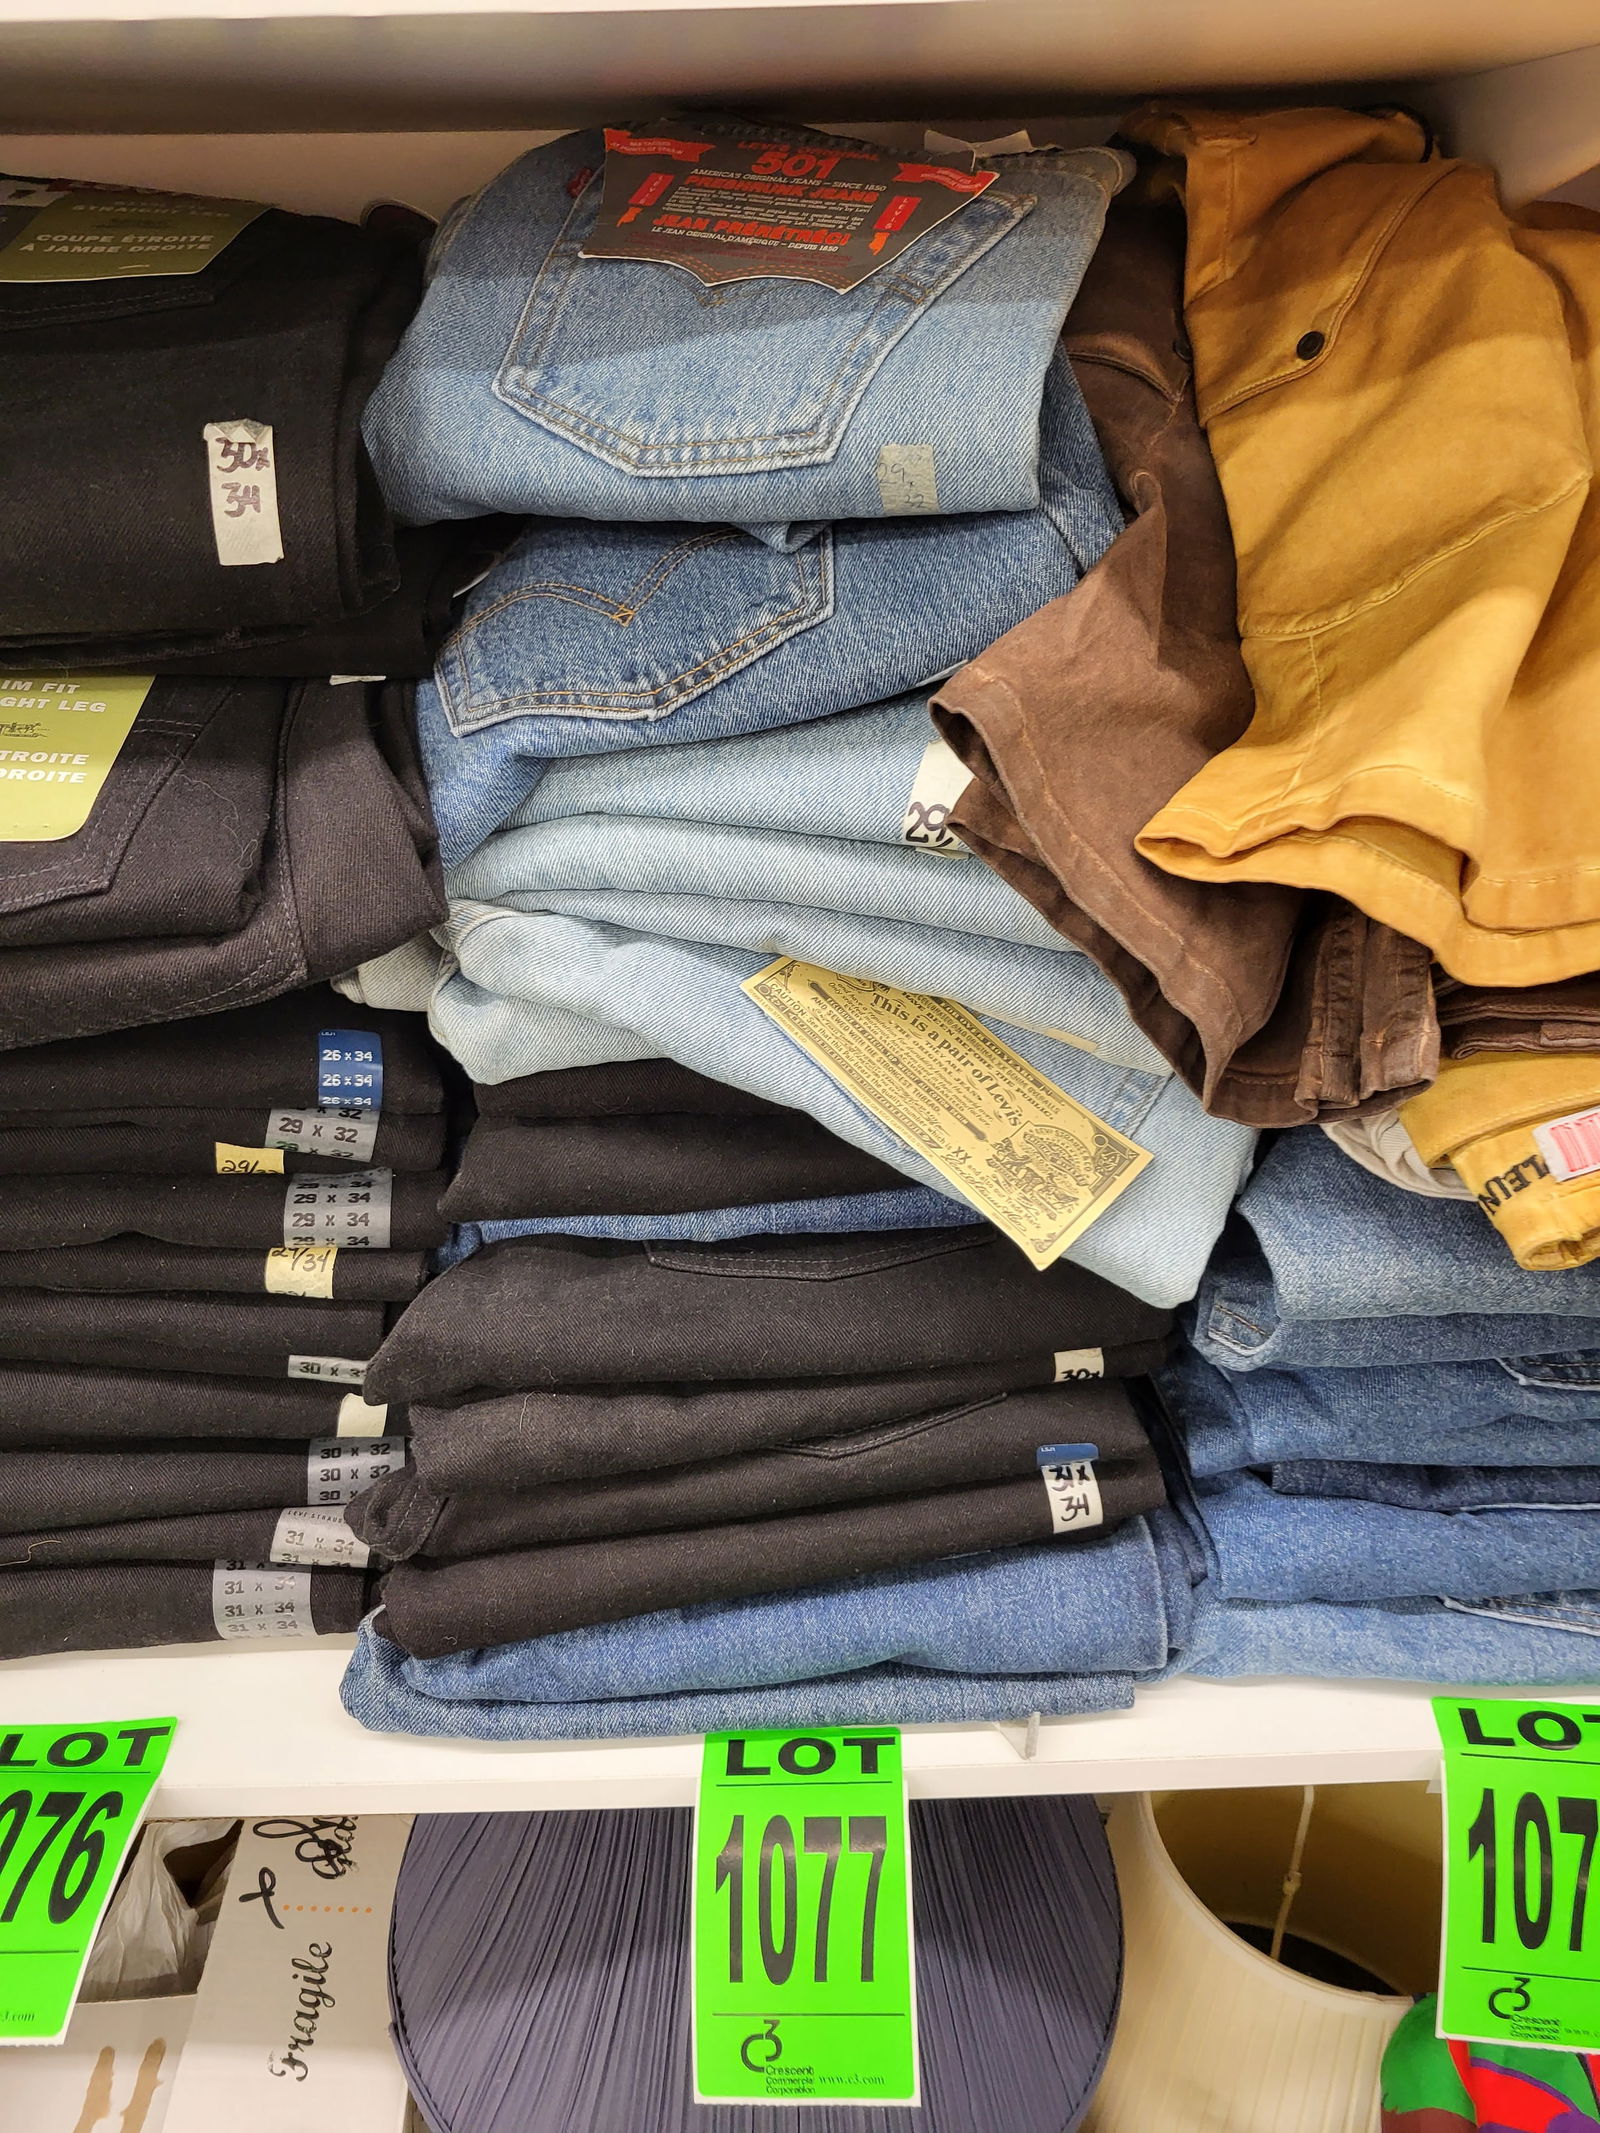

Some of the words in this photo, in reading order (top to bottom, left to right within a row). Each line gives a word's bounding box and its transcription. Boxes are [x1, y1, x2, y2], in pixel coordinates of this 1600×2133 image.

[751, 151, 841, 180] 501
[742, 173, 789, 184] ORIGINAL
[790, 178, 822, 186] JEANS
[832, 181, 862, 190] SINCE
[652, 214, 710, 230] JEAN
[36, 233, 115, 243] COUPE
[121, 232, 214, 244] ÉTROITE
[663, 227, 685, 236] JEAN
[686, 230, 726, 241] ORIGINAL
[788, 242, 818, 251] DEPUIS
[44, 244, 121, 254] JAMBE
[129, 242, 211, 252] DROITE
[221, 481, 262, 518] 34
[42, 683, 80, 694] FIT
[57, 699, 107, 713] LEG
[810, 994, 828, 1010] AND
[825, 1009, 851, 1032] SEWED
[847, 1028, 866, 1046] WITH
[864, 1044, 879, 1058] THE
[874, 1055, 913, 1089] STRONGEST
[868, 990, 911, 1022] This
[909, 1014, 930, 1034] is
[926, 1028, 940, 1042] a
[937, 1036, 976, 1072] pair
[969, 1064, 994, 1088] of
[322, 1049, 342, 1061] 26
[354, 1049, 373, 1062] 34
[322, 1074, 342, 1087] 26
[354, 1074, 373, 1088] 34
[806, 1016, 819, 1028] See
[816, 1026, 832, 1041] that
[829, 1038, 844, 1052] this
[841, 1049, 857, 1064] Pair
[852, 1060, 872, 1079] bears
[870, 1077, 883, 1089] the
[879, 1086, 905, 1109] quality
[901, 1105, 928, 1128] number
[925, 1126, 946, 1145] which
[951, 1144, 972, 1164] XX
[322, 1097, 342, 1105] 26
[354, 1097, 373, 1106] 34
[279, 1117, 304, 1135] 29
[334, 1126, 359, 1143] 32
[293, 1193, 317, 1204] 29
[348, 1192, 371, 1203] 34
[292, 1212, 316, 1227] 29
[347, 1212, 370, 1227] 34
[292, 1236, 316, 1246] 29
[347, 1236, 370, 1246] 34
[320, 1447, 341, 1459] 30
[370, 1443, 391, 1455] 32
[320, 1468, 341, 1482] 30
[370, 1465, 391, 1479] 32
[320, 1490, 341, 1501] 30
[1059, 1493, 1090, 1521] 34
[285, 1530, 305, 1547] 31
[333, 1538, 355, 1555] 34
[224, 1580, 245, 1595] 31
[275, 1576, 296, 1591] 34
[224, 1603, 245, 1617] 31
[274, 1601, 295, 1614] 34
[227, 1622, 250, 1632] 31
[277, 1619, 299, 1631] 34
[0, 1726, 172, 1768] LOT
[725, 1737, 896, 1776] LOT
[1468, 1788, 1600, 1952] 107
[715, 1814, 887, 1986] 1077
[267, 1941, 336, 2082] Fragile
[765, 2065, 815, 2076] Crescent
